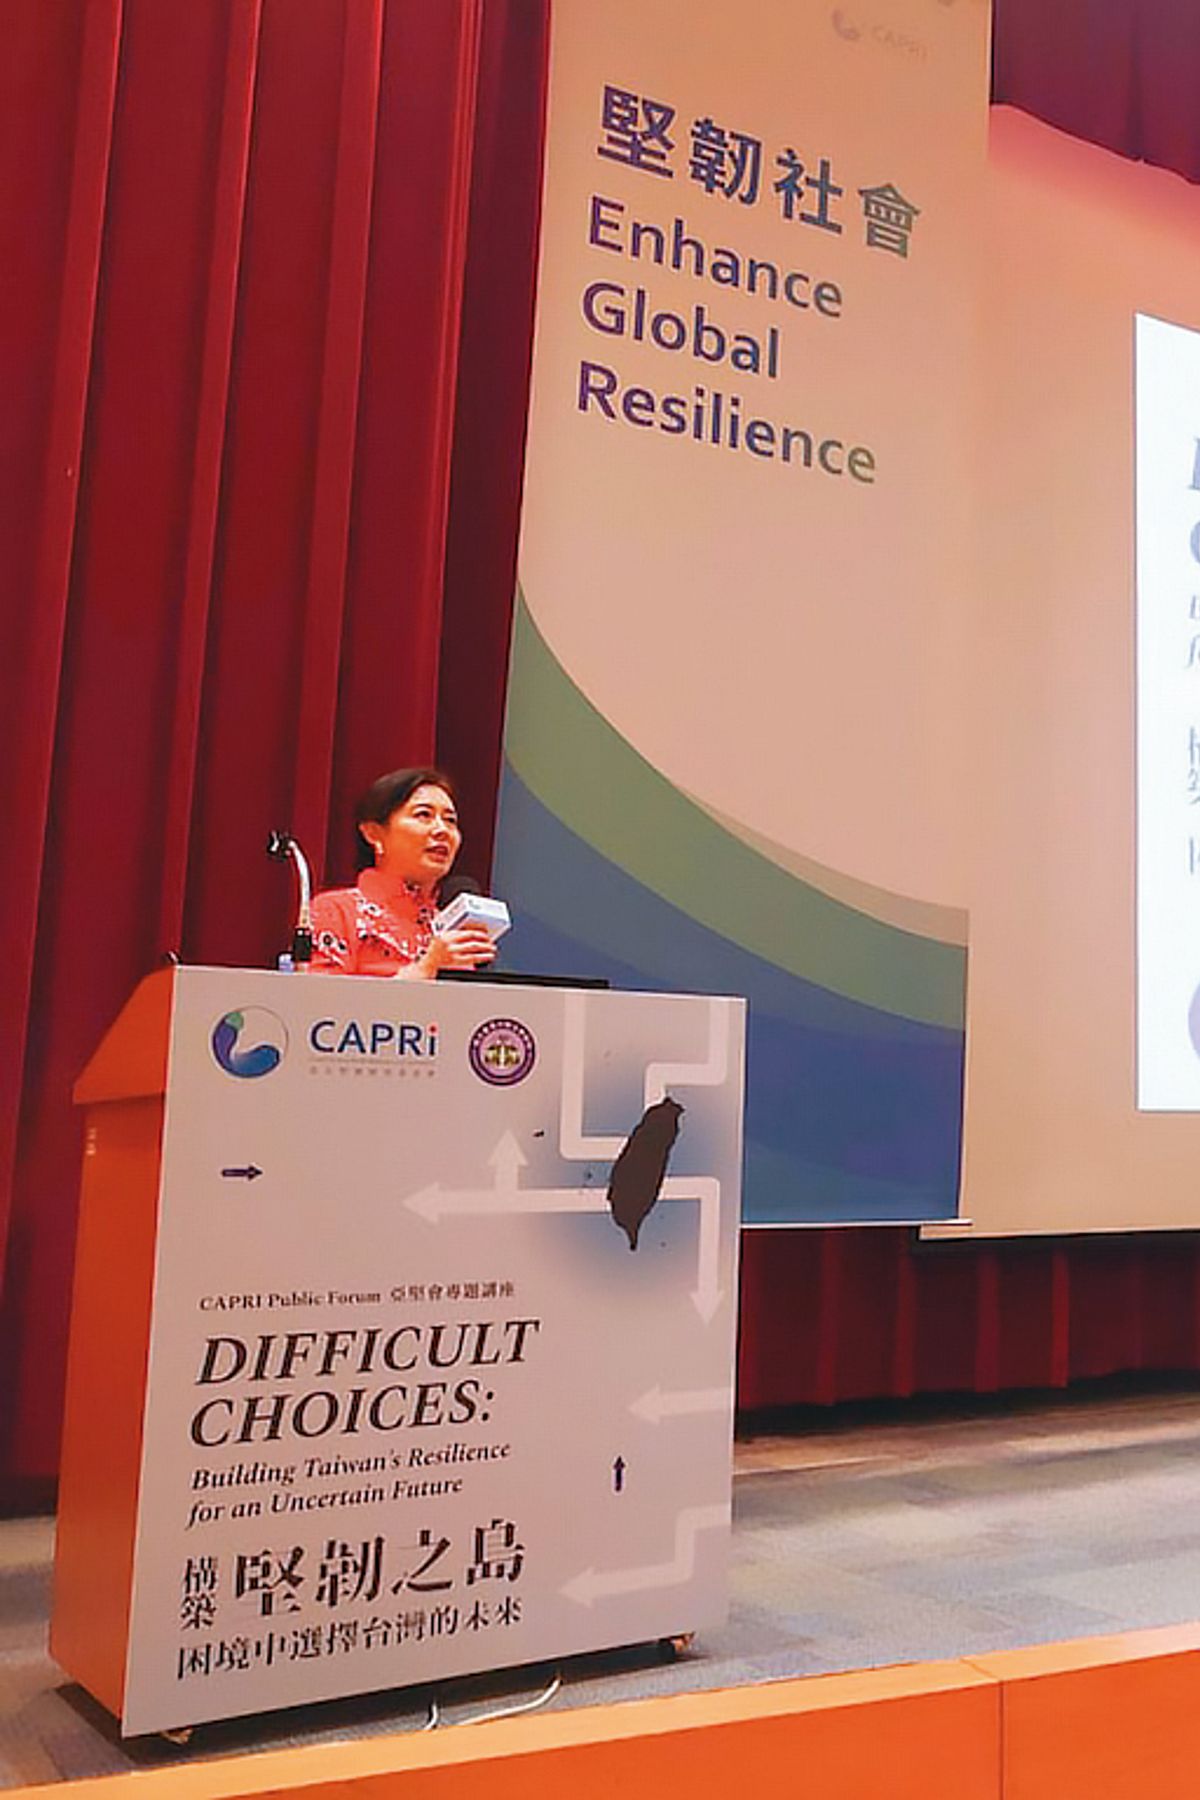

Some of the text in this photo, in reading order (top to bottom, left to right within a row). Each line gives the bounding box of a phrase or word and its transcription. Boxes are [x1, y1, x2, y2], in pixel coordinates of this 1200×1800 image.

[597, 84, 921, 258] 堅韌社會
[588, 194, 843, 317] Enhance
[581, 281, 779, 377] Global
[576, 360, 876, 483] Resilience
[200, 1295, 263, 1312] CAPRI
[267, 1290, 323, 1309] Public
[327, 1288, 381, 1305] Forum
[195, 1319, 540, 1386] DIFFICULT
[190, 1379, 495, 1447] CHOICES:
[185, 1474, 464, 1531] for an Uncertain Future
[191, 1442, 512, 1491] Building Taiwan's Resilience
[180, 1556, 218, 1631] 構築
[234, 1517, 526, 1617] 堅韌之島
[177, 1595, 523, 1681] 困境中選擇台灣的未來
